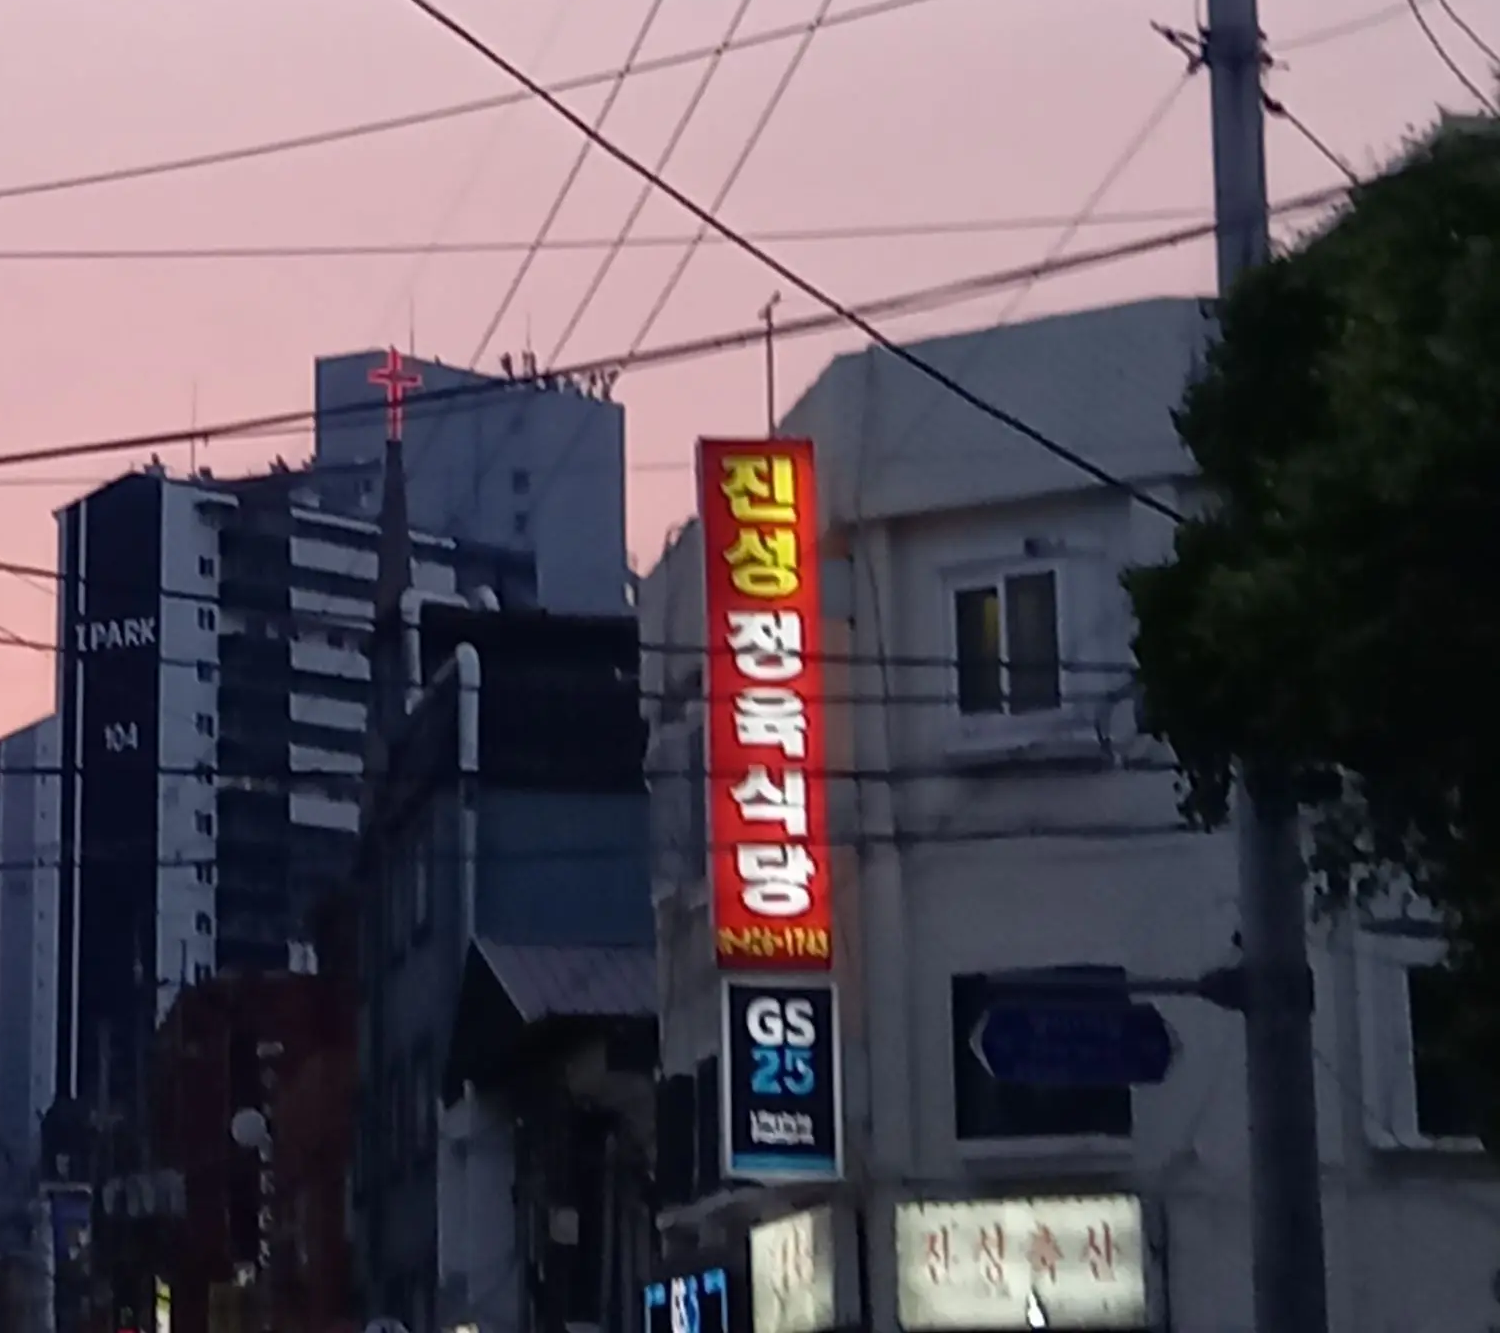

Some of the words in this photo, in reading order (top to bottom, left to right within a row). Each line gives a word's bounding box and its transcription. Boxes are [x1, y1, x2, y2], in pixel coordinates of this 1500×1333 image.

[720, 454, 800, 599] 진성
[727, 610, 815, 916] 정육식당
[746, 996, 816, 1046] GS
[750, 1046, 816, 1095] 25
